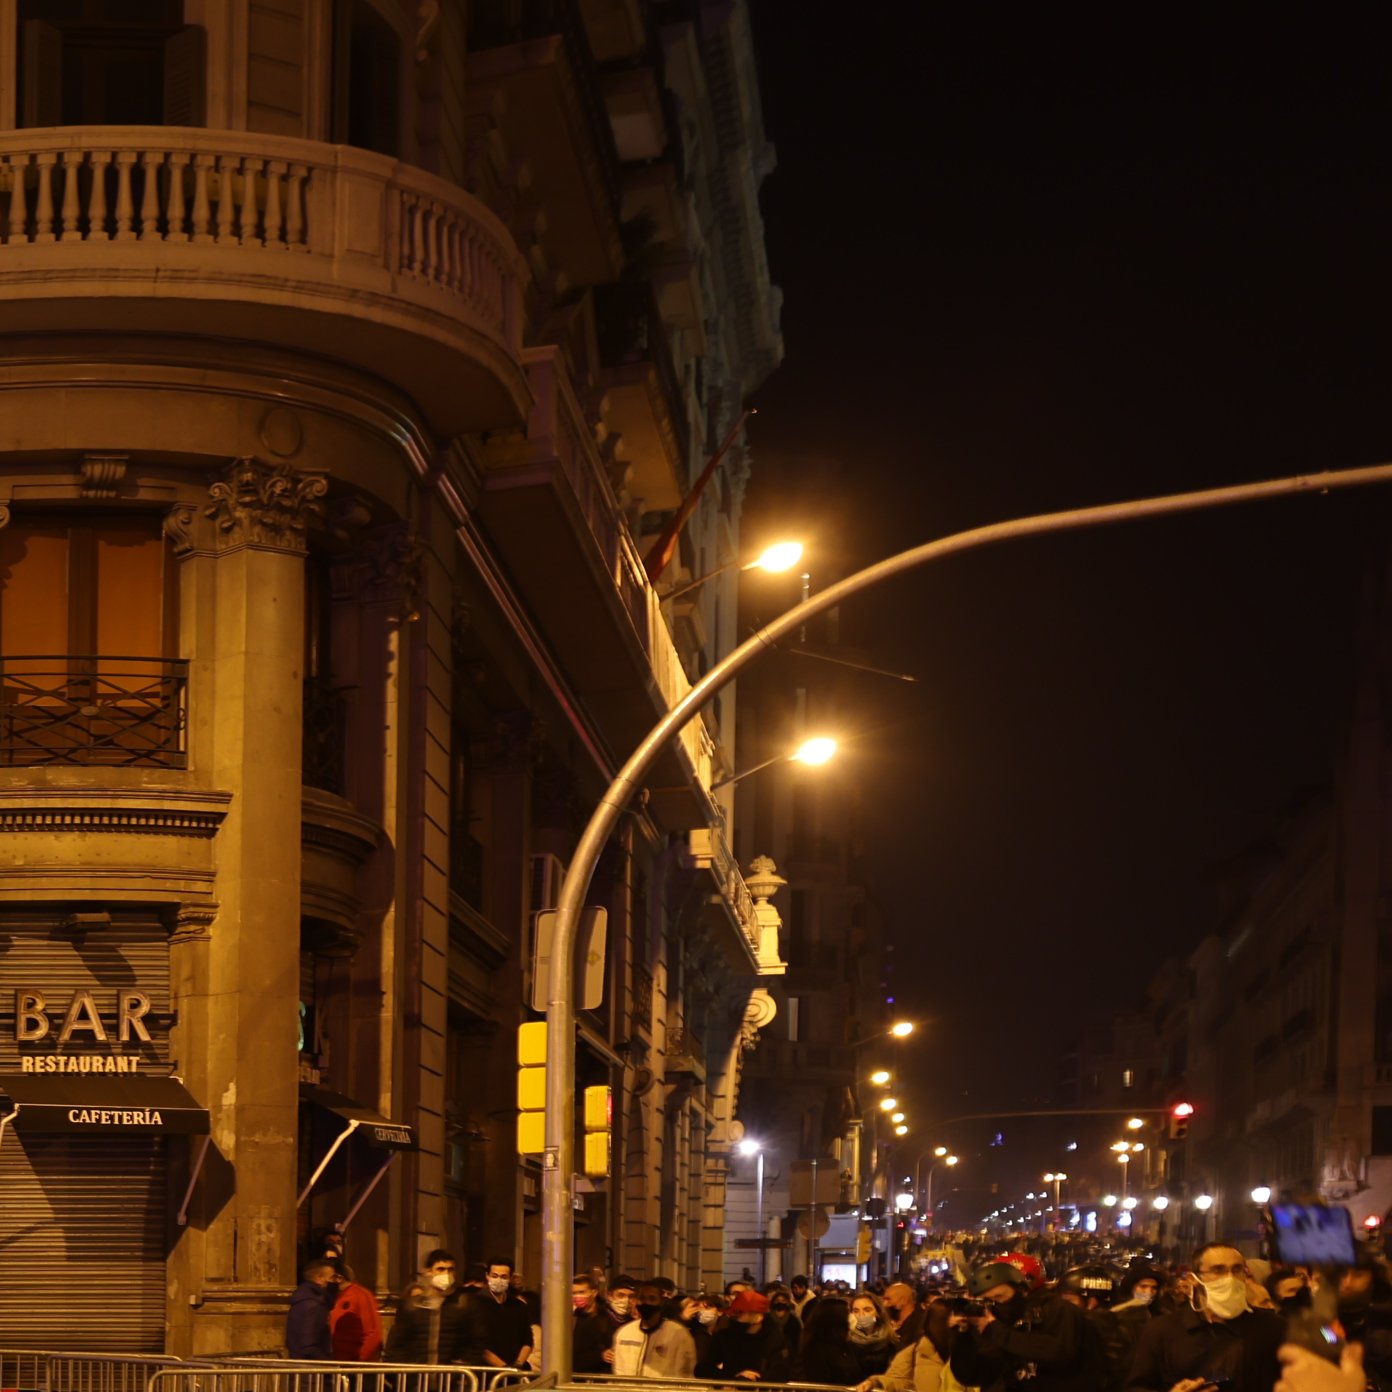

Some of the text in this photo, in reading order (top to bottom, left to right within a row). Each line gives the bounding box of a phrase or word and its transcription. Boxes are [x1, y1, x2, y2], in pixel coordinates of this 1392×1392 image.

[16, 988, 153, 1041] BAR
[21, 1056, 140, 1073] RESTAURANT
[68, 1108, 163, 1125] CAFETERÍA
